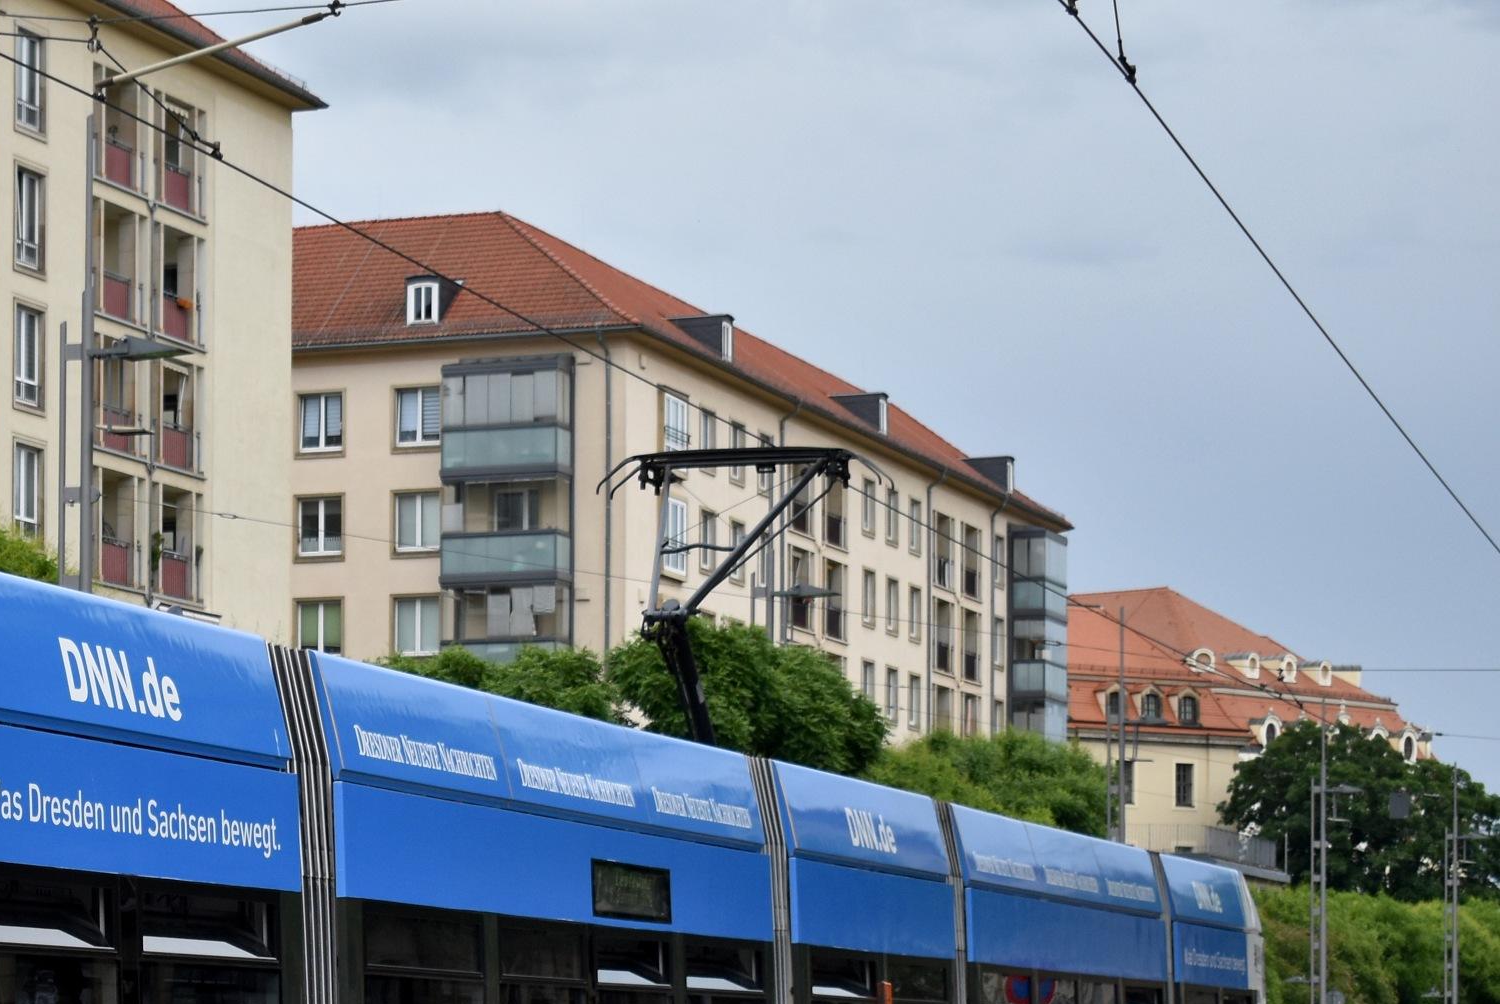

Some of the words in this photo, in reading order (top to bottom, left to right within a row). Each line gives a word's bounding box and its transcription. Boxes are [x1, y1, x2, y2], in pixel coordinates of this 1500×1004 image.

[58, 637, 183, 722] DNN.de
[352, 724, 404, 763] DRESDNER
[400, 734, 442, 771] NEUESTE
[437, 742, 498, 780] NACHRICHTEN
[28, 783, 105, 832] Dresden
[111, 798, 143, 835] und
[148, 799, 217, 844] Sachsen
[221, 809, 282, 859] bewegt.
[844, 806, 898, 855] DNN.de
